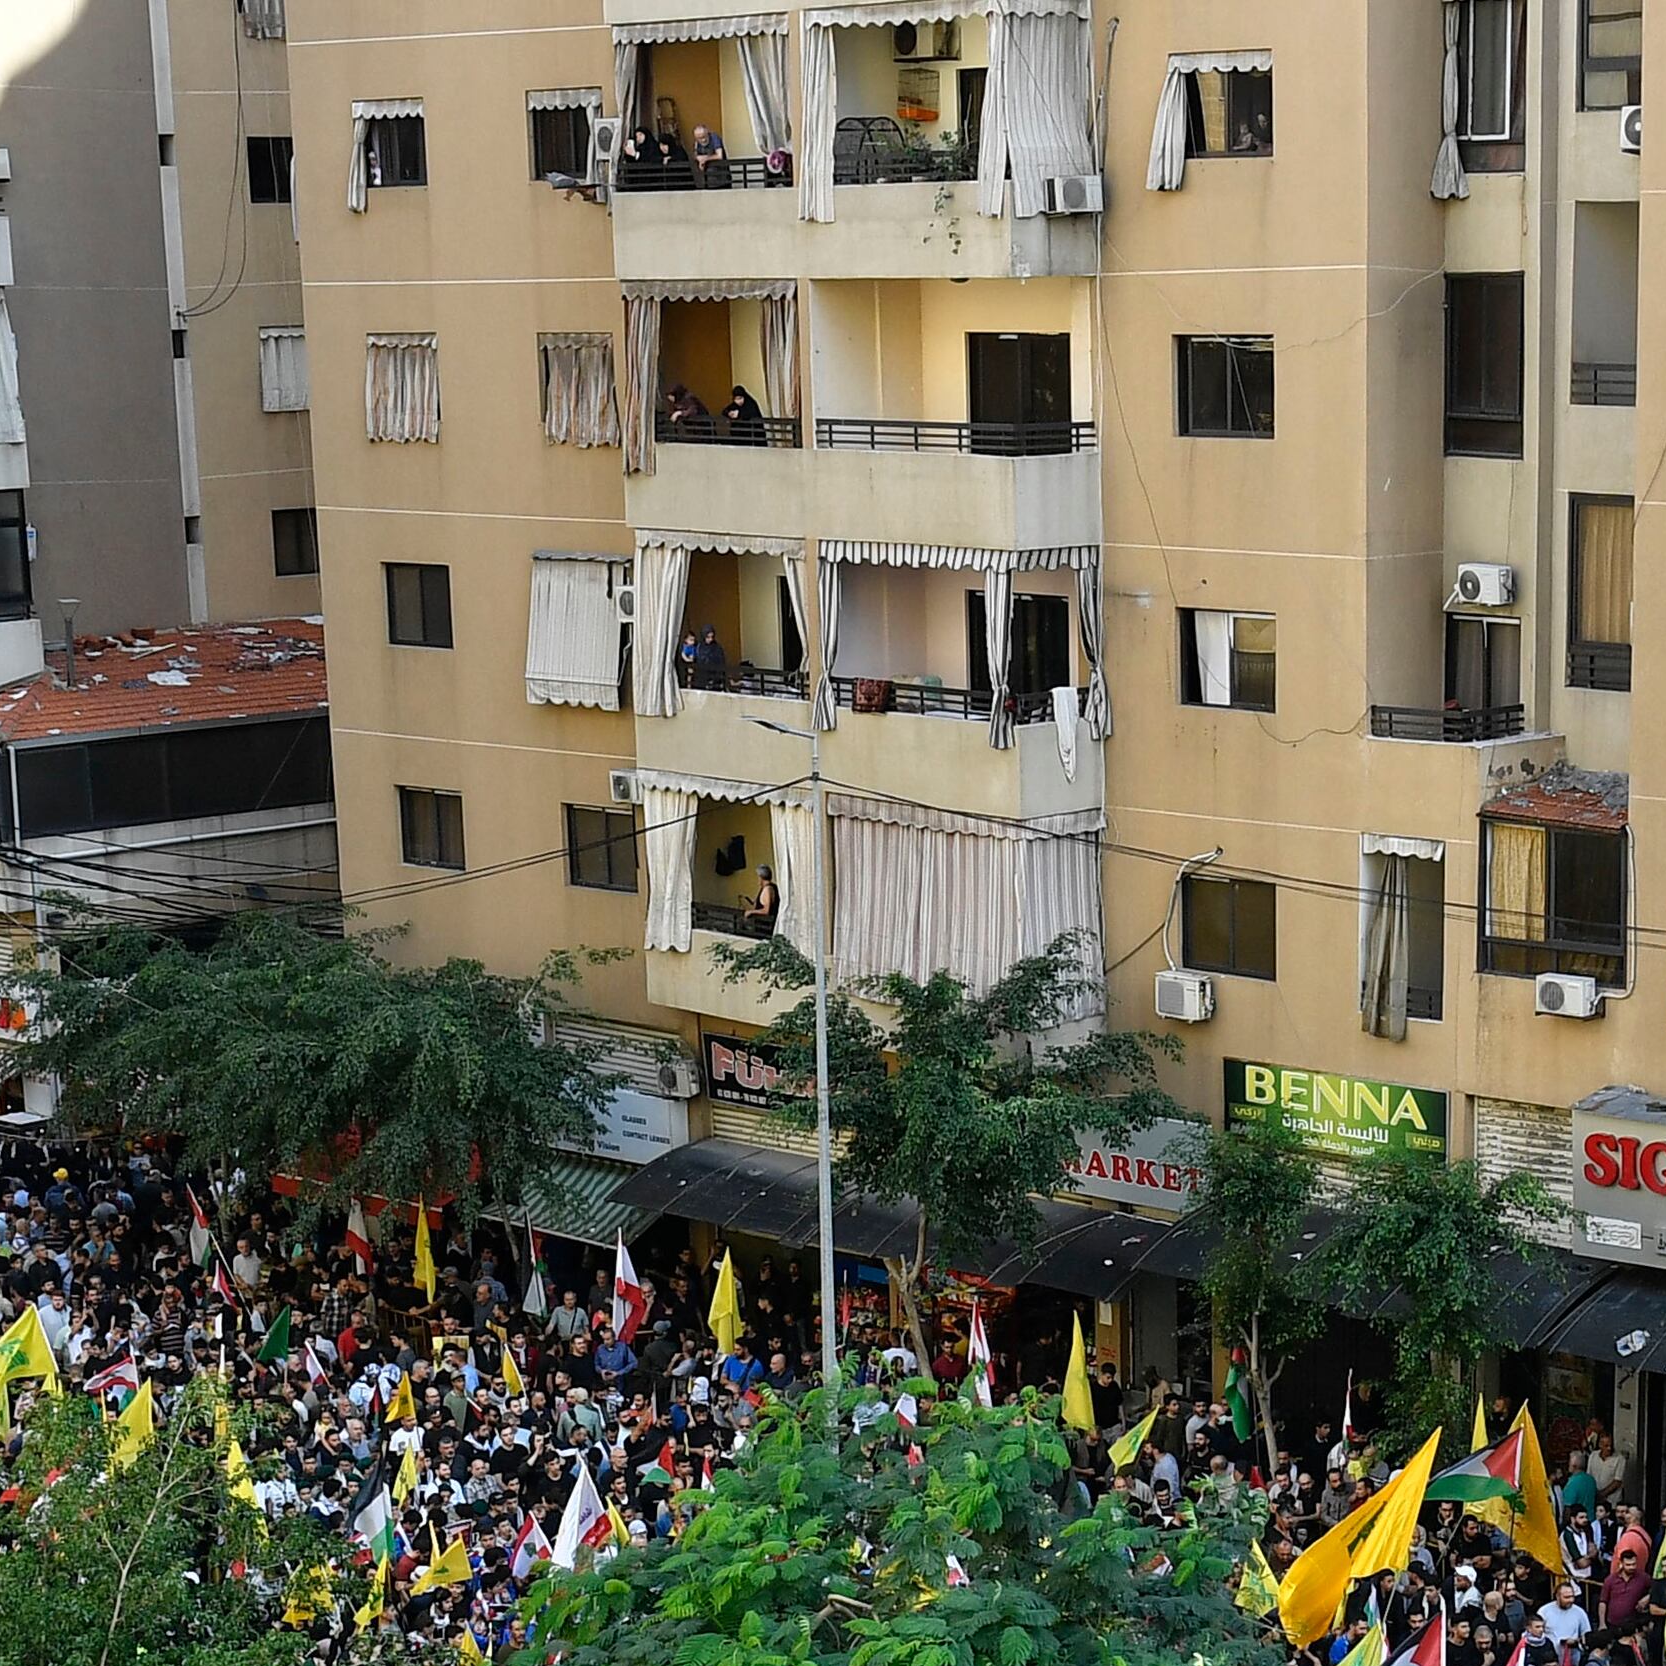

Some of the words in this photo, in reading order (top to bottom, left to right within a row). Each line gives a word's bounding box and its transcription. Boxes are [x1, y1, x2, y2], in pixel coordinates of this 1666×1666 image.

[1245, 1064, 1427, 1130] BENNA
[622, 1130, 649, 1141] CONTACT
[596, 1140, 621, 1151] Vision
